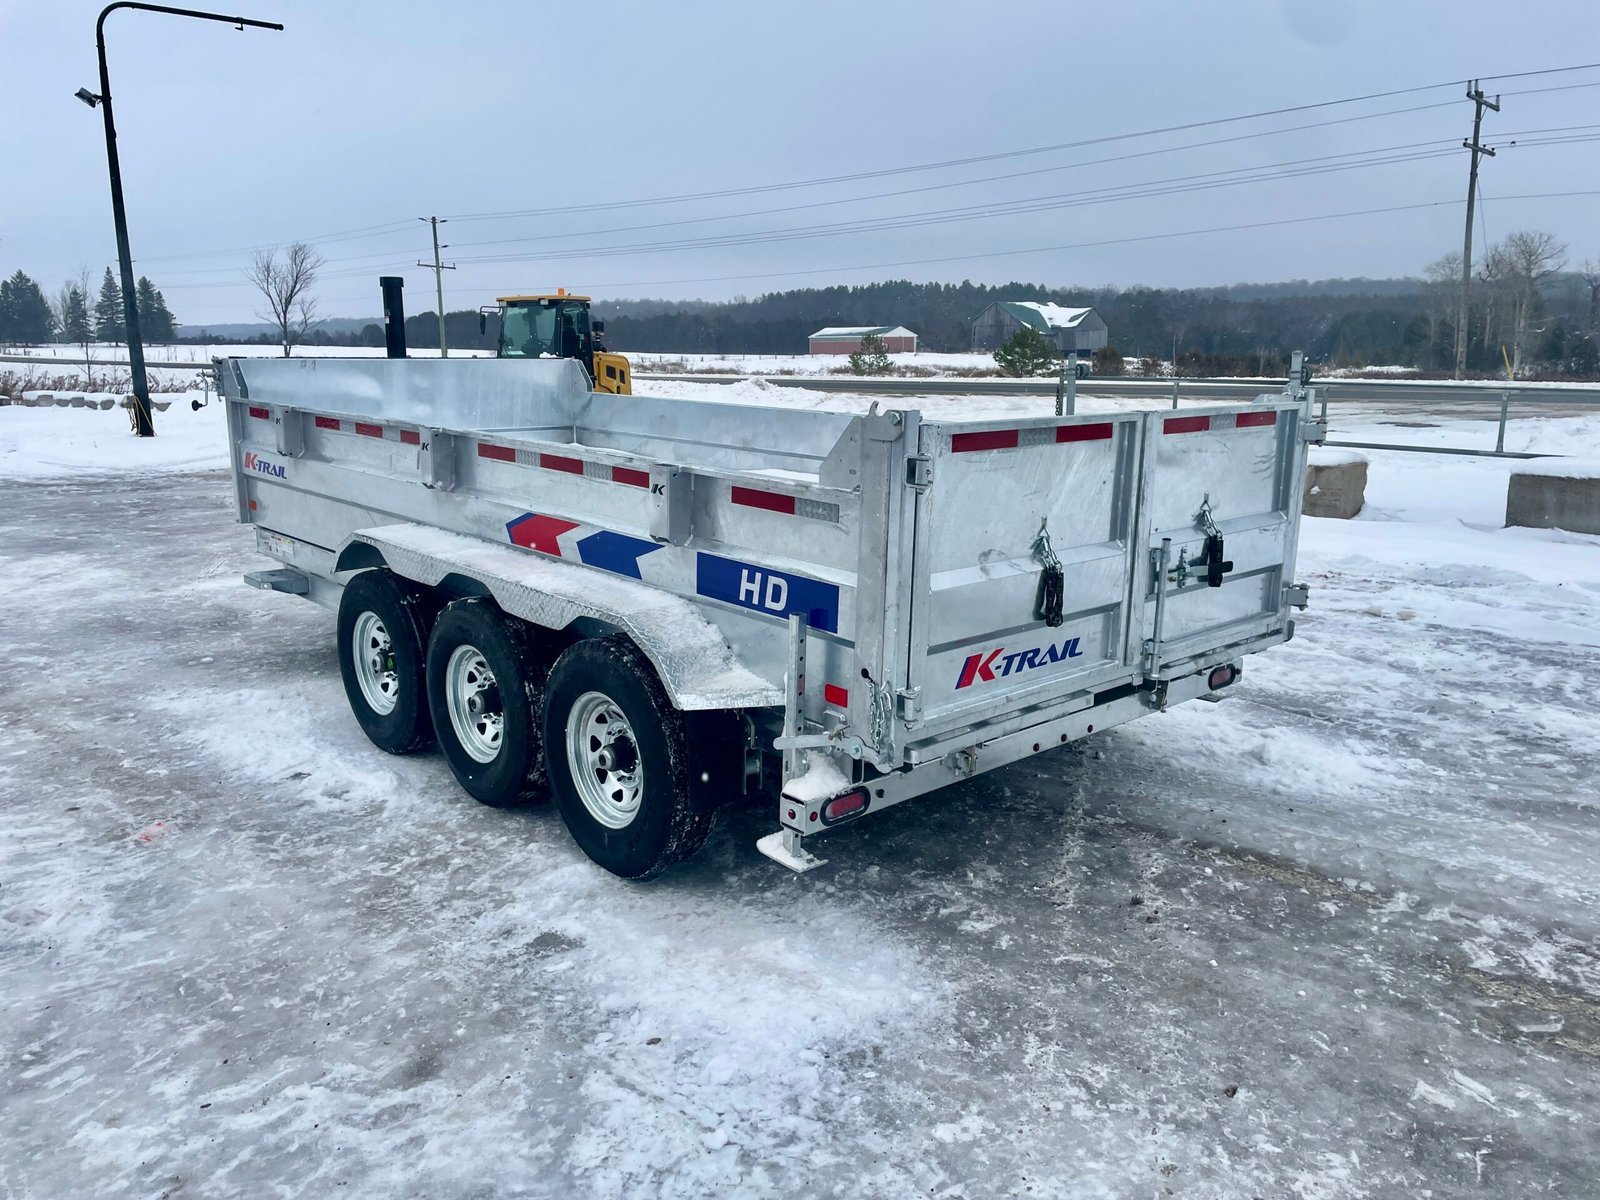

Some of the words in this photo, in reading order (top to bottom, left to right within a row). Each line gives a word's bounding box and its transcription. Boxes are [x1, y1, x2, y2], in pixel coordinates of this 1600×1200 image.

[421, 442, 429, 451] K
[244, 451, 287, 480] K-TRAIL
[650, 483, 665, 496] K
[739, 568, 788, 611] HD
[954, 637, 1083, 690] K-TRAIL
